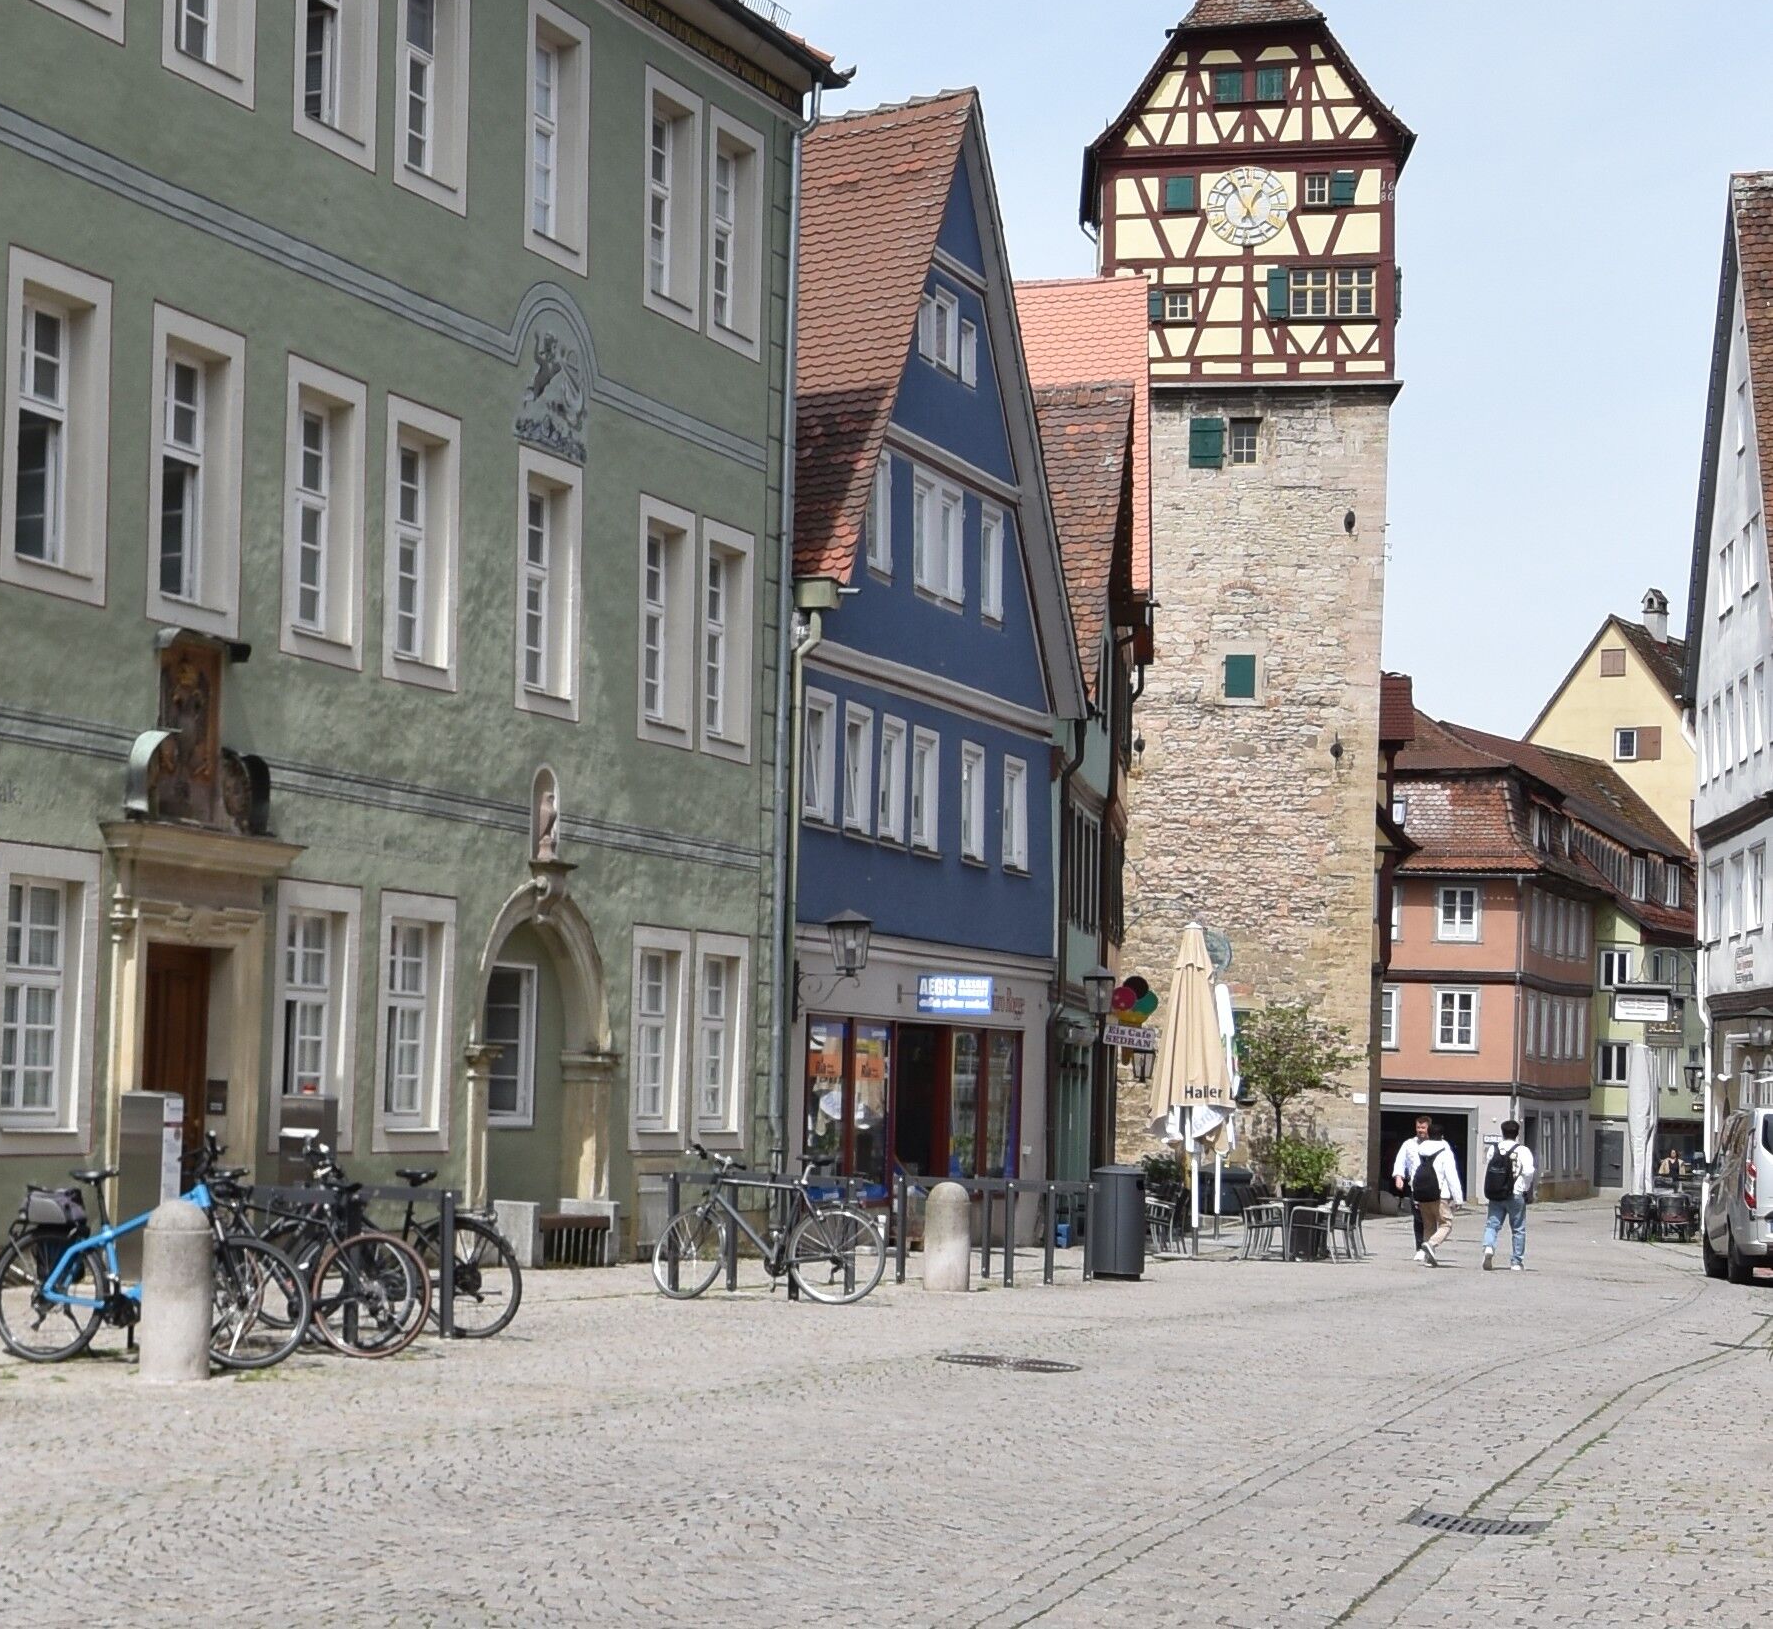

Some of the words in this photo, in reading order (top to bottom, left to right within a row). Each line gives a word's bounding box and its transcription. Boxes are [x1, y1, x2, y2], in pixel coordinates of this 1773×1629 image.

[919, 978, 957, 996] AEGIS
[1109, 1025, 1126, 1035] Eis
[1184, 1085, 1223, 1099] Haller
